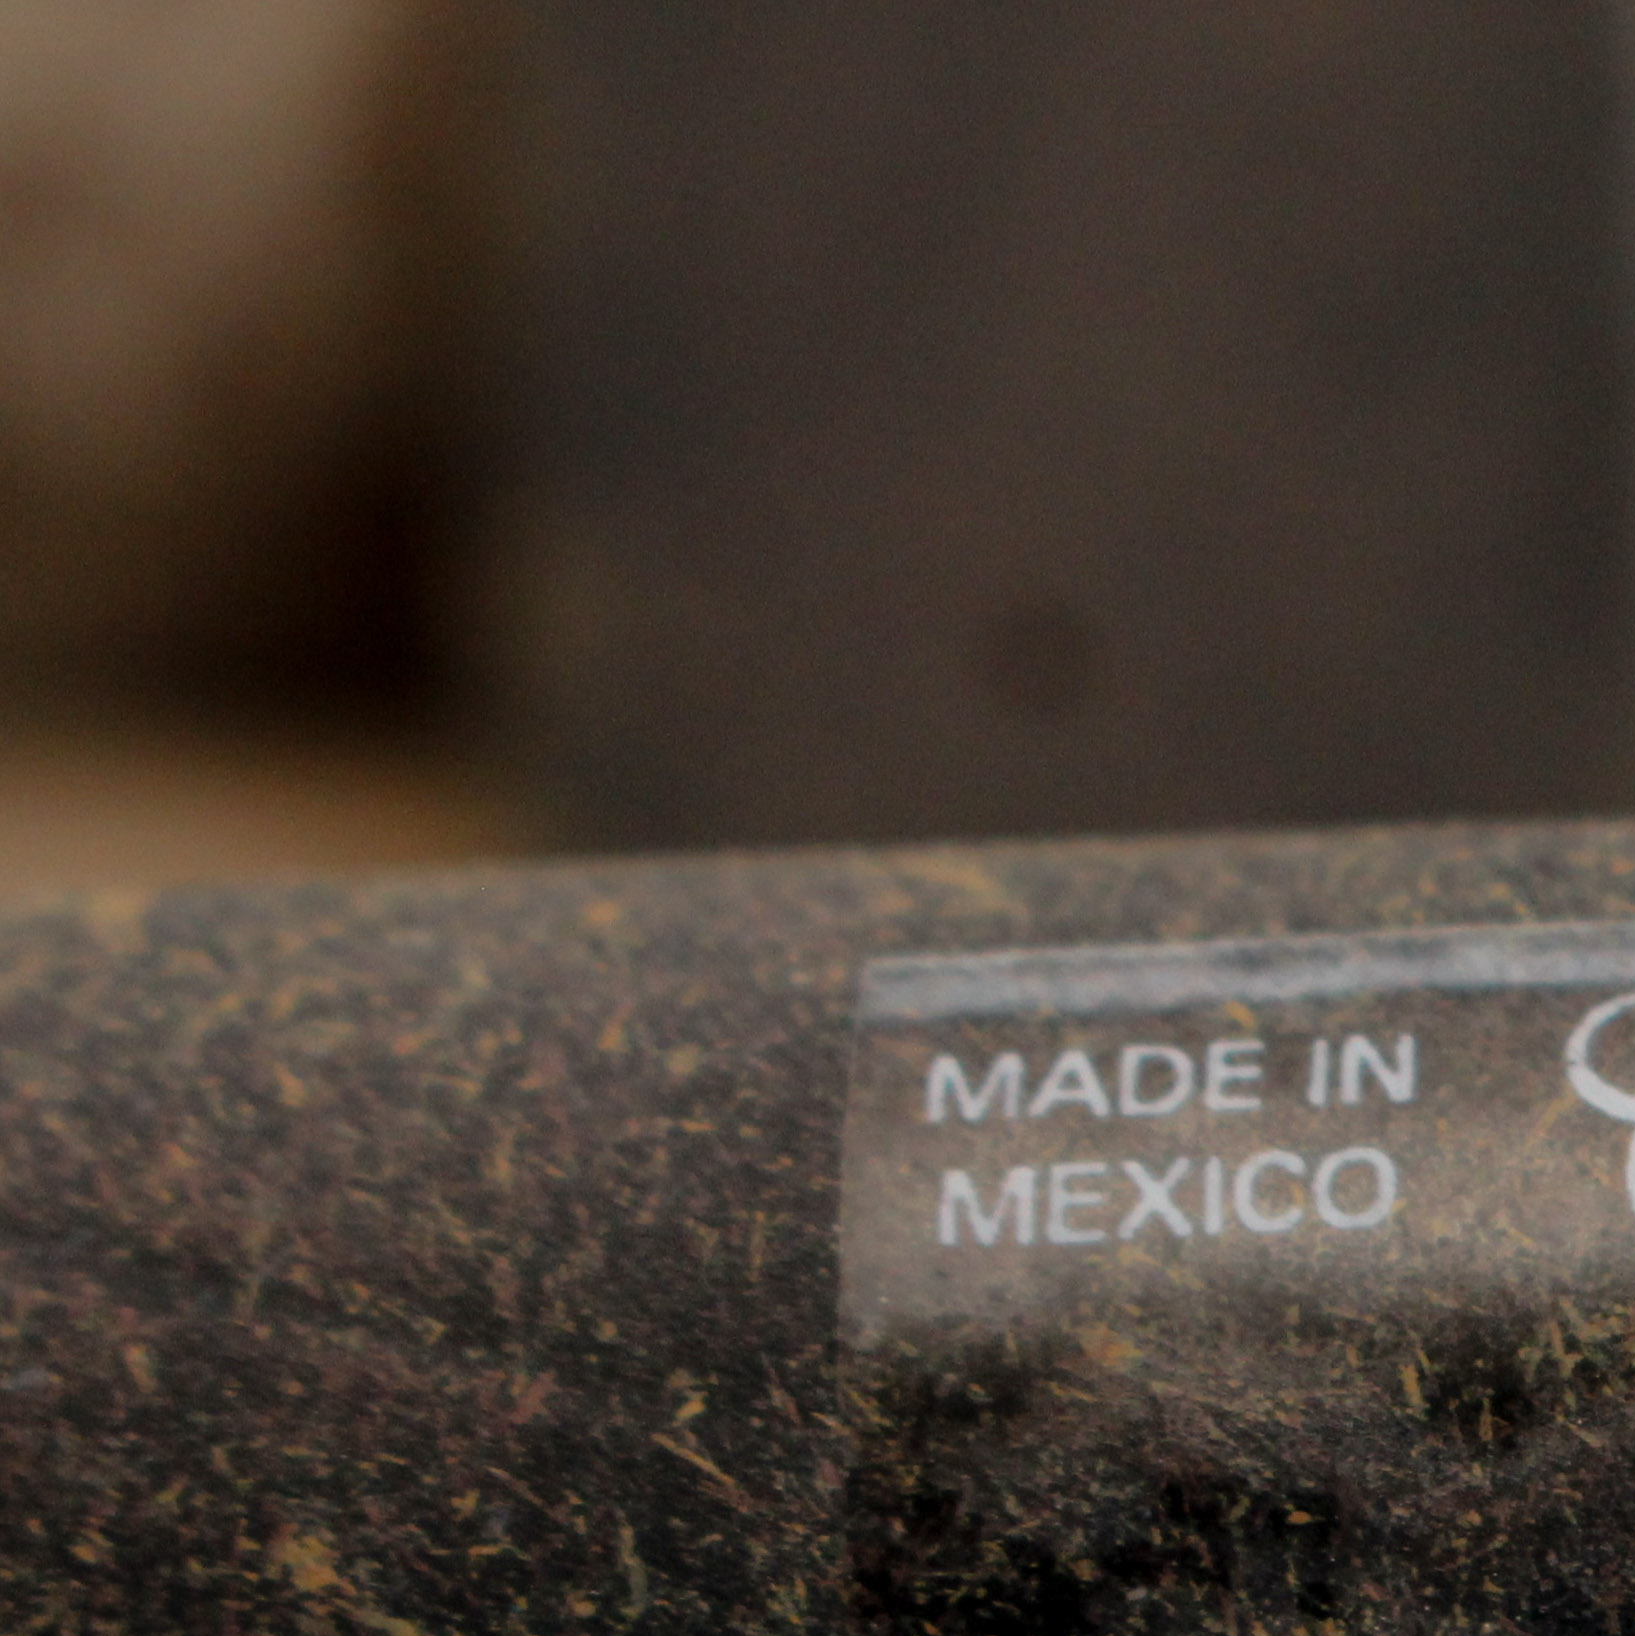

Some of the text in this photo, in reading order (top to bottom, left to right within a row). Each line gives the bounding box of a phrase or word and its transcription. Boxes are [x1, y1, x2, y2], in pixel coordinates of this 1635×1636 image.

[923, 1032, 1416, 1123] MADE IN
[936, 1146, 1396, 1246] MEXICO
